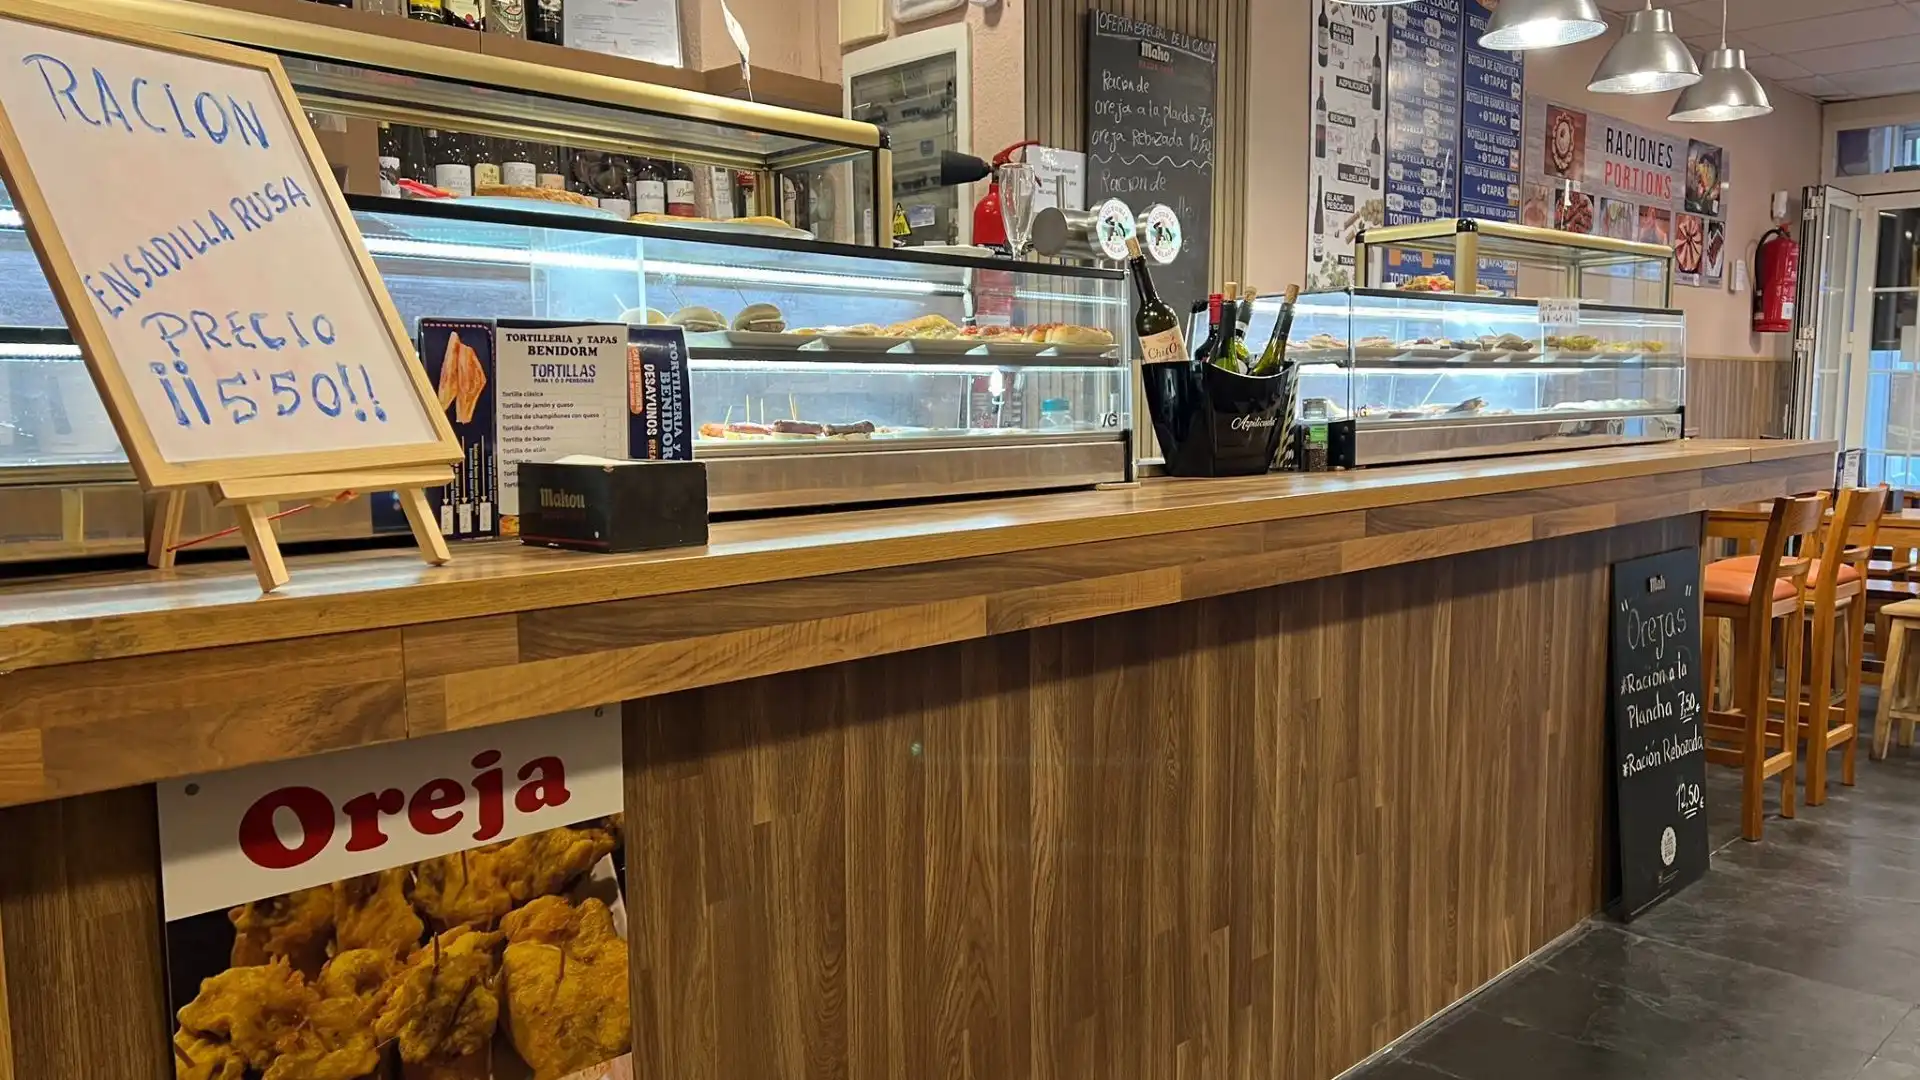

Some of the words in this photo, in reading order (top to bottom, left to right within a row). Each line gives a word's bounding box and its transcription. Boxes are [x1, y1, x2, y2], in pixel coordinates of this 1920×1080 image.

[23, 52, 270, 151] RACION
[1489, 75, 1508, 90] TAPAS
[1488, 111, 1507, 126] TAPAS
[1487, 154, 1506, 168] TAPAS
[1605, 127, 1674, 169] RACIONES
[1487, 184, 1505, 198] TAPAS
[1604, 160, 1673, 200] PORTIONS
[229, 175, 312, 232] RUSA
[141, 310, 338, 357] PRECIO
[506, 333, 573, 344] TORTILLERIA
[587, 335, 618, 344] TAPAS
[527, 345, 598, 356] BENIDORM
[531, 364, 596, 378] TORTILLAS
[668, 340, 683, 438] TORTILLERIA
[643, 363, 658, 436] DESAYUNOS
[660, 371, 674, 460] BENIDOR
[540, 488, 585, 509] Mahou
[1627, 690, 1673, 729] Plancha
[1662, 724, 1704, 764] Rebozada
[239, 749, 571, 869] Oreja
